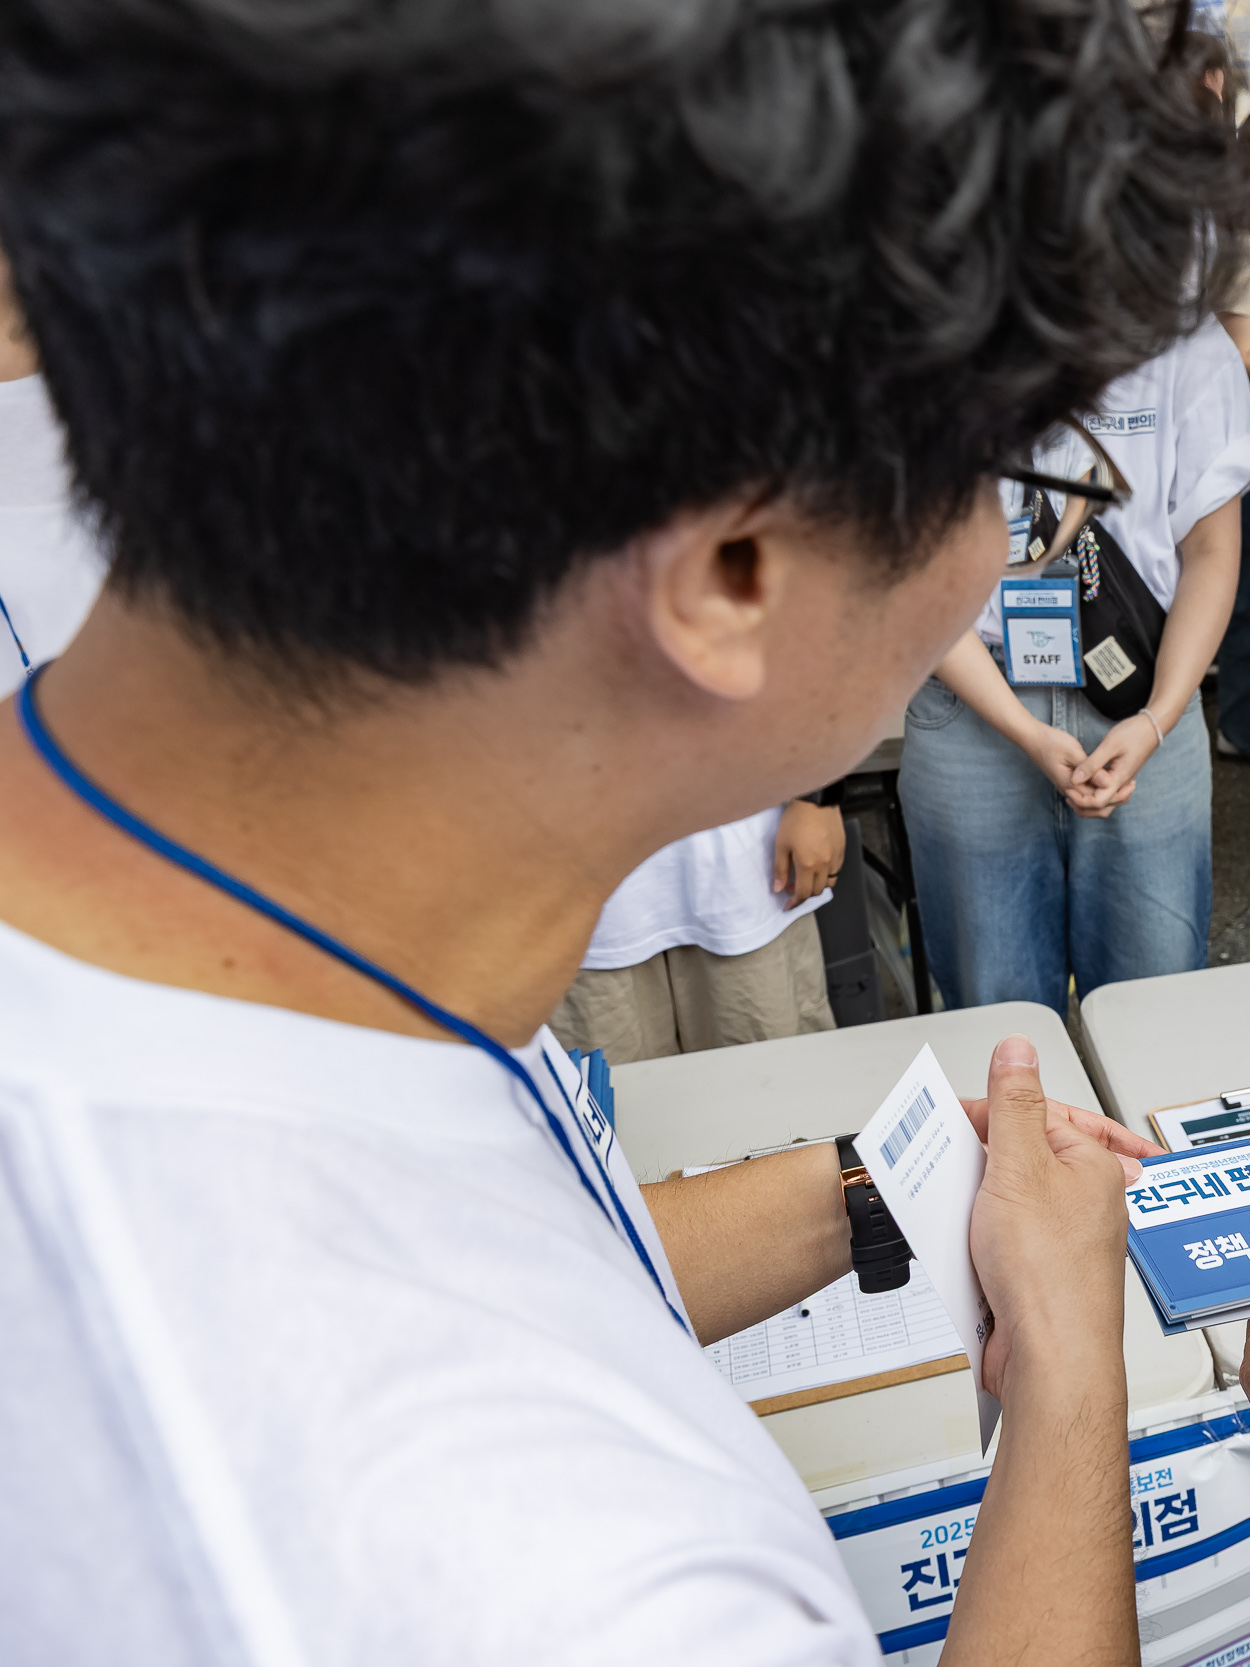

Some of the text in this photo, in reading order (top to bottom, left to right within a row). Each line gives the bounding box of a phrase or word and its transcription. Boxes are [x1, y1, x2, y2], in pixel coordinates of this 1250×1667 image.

[1128, 413, 1156, 430] 편의
[1023, 654, 1062, 665] STAFF
[1149, 1168, 1180, 1182] 2025
[1126, 1172, 1232, 1214] 진구네
[920, 1517, 976, 1549] 2025
